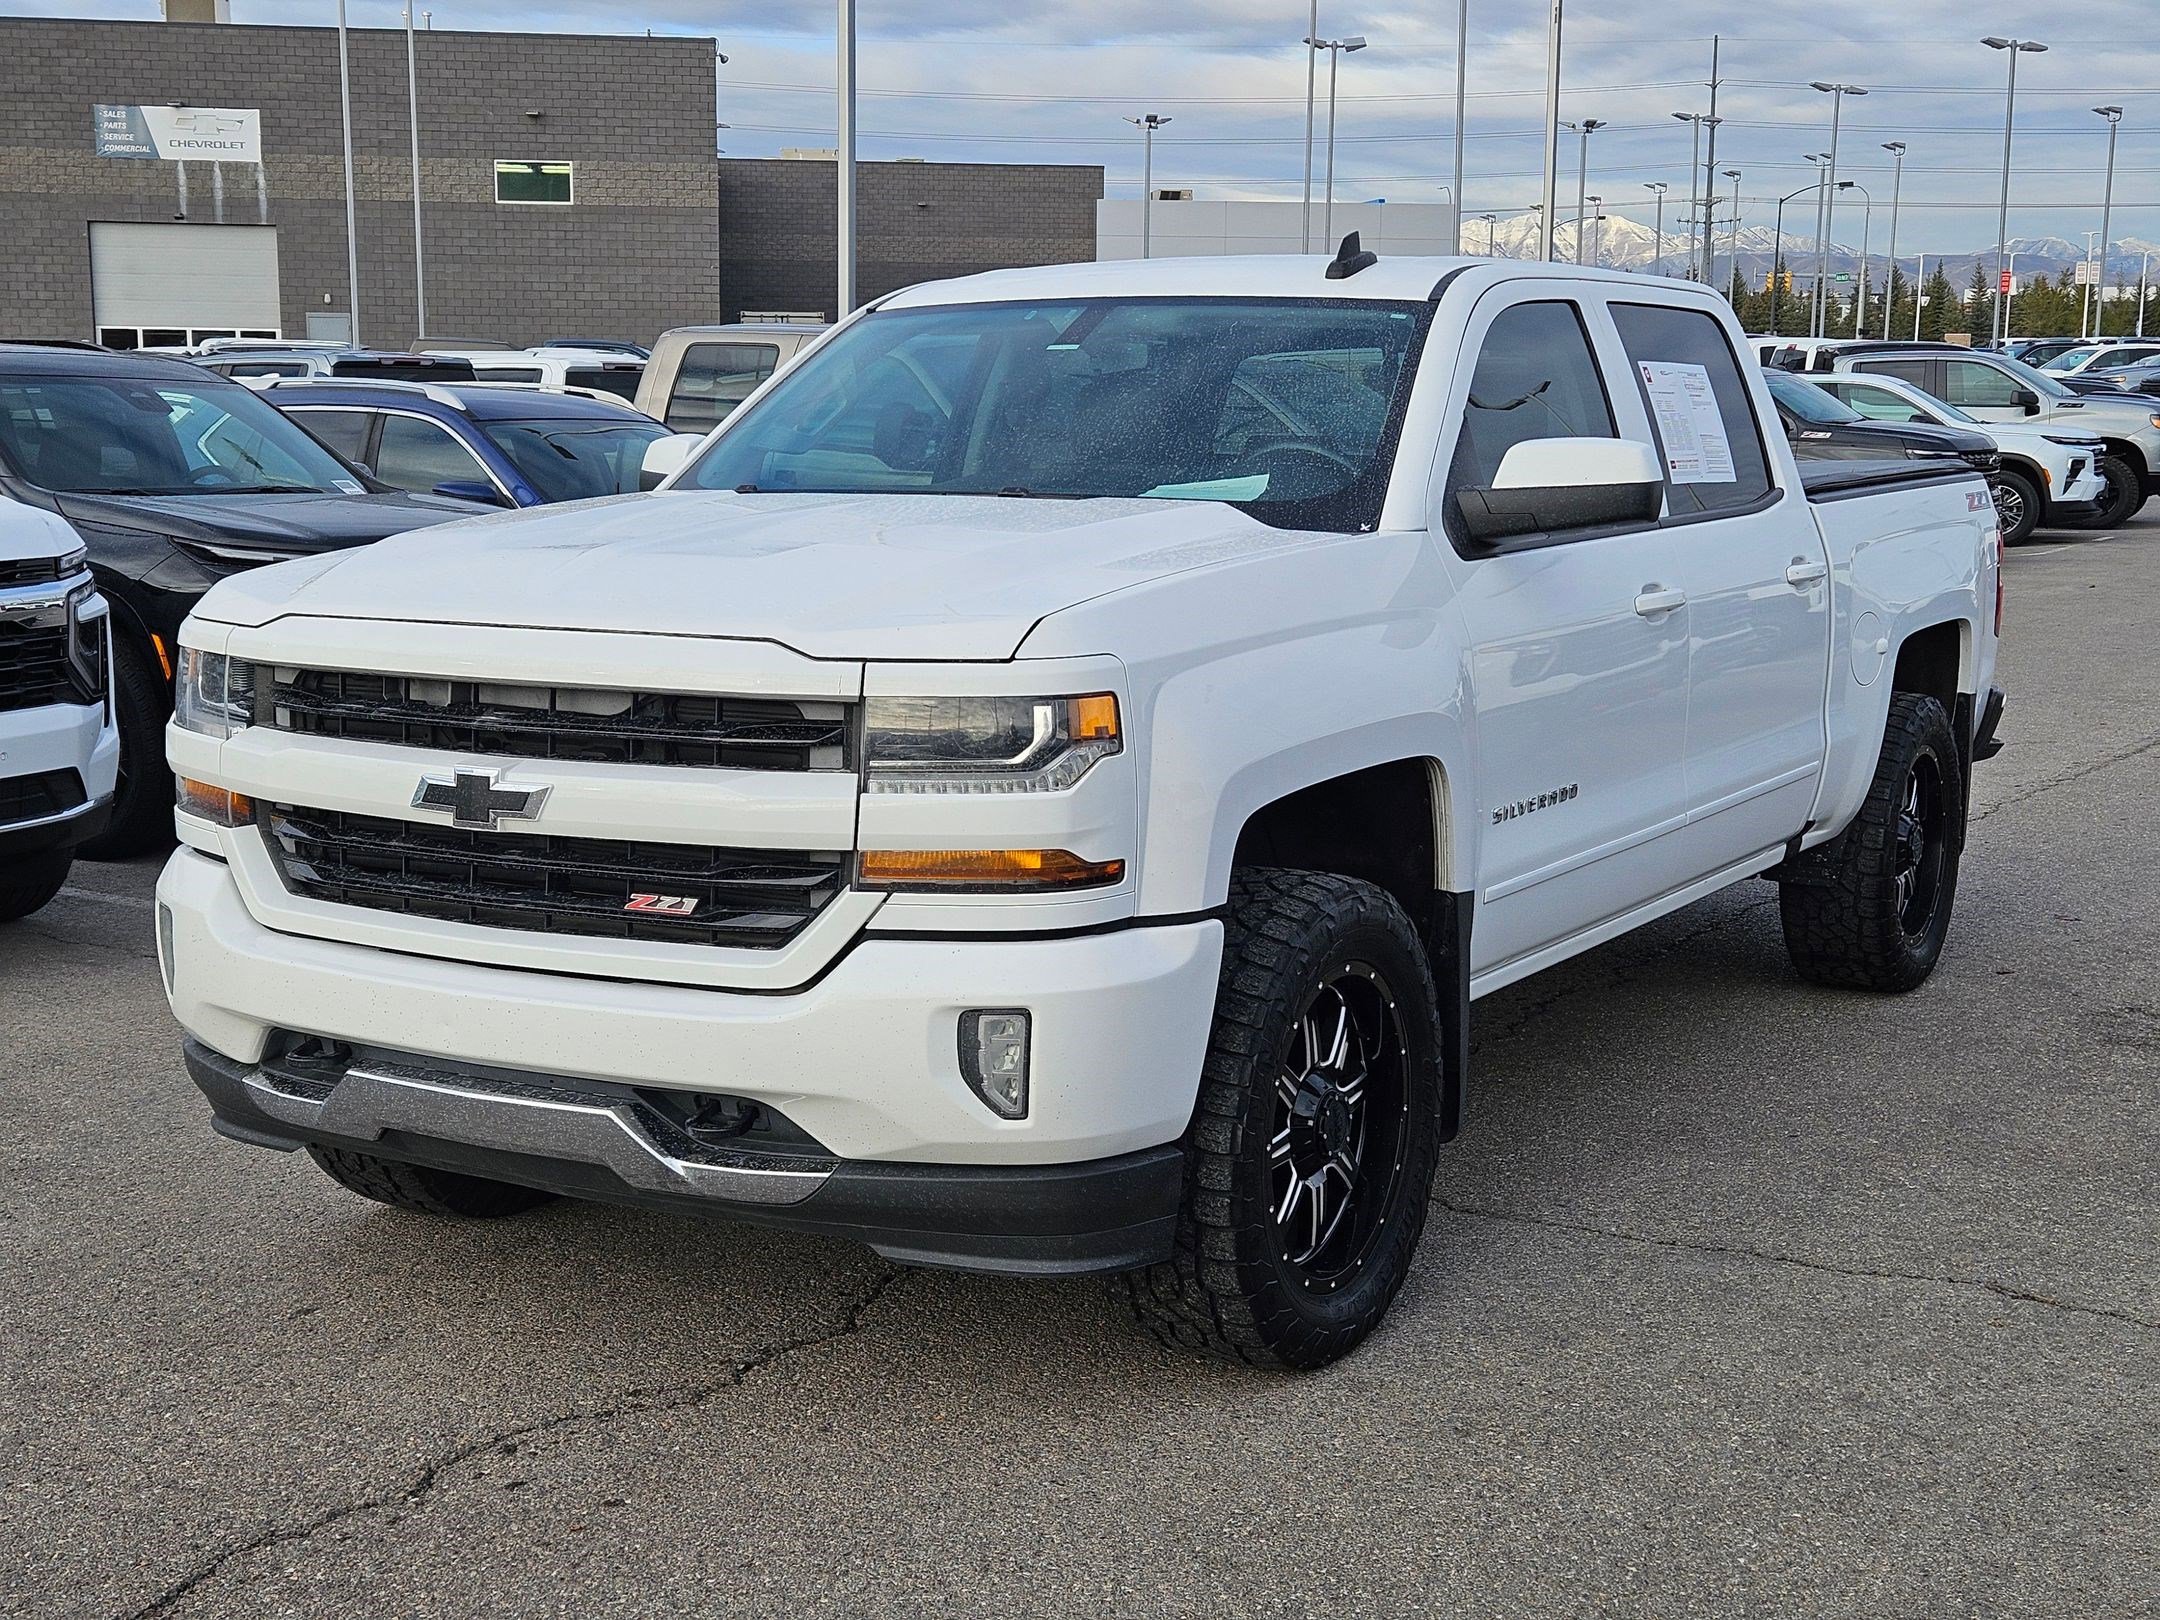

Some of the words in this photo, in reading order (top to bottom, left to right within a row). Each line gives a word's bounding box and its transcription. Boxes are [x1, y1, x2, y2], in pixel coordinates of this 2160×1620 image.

[102, 110, 127, 119] SALES
[103, 122, 127, 130] PARTS
[103, 133, 135, 142] SERVICE
[104, 144, 151, 154] COMMERCIAL
[169, 139, 246, 150] CHEVROLET
[1491, 783, 1579, 825] SILVERADO
[624, 893, 699, 915] Z71
